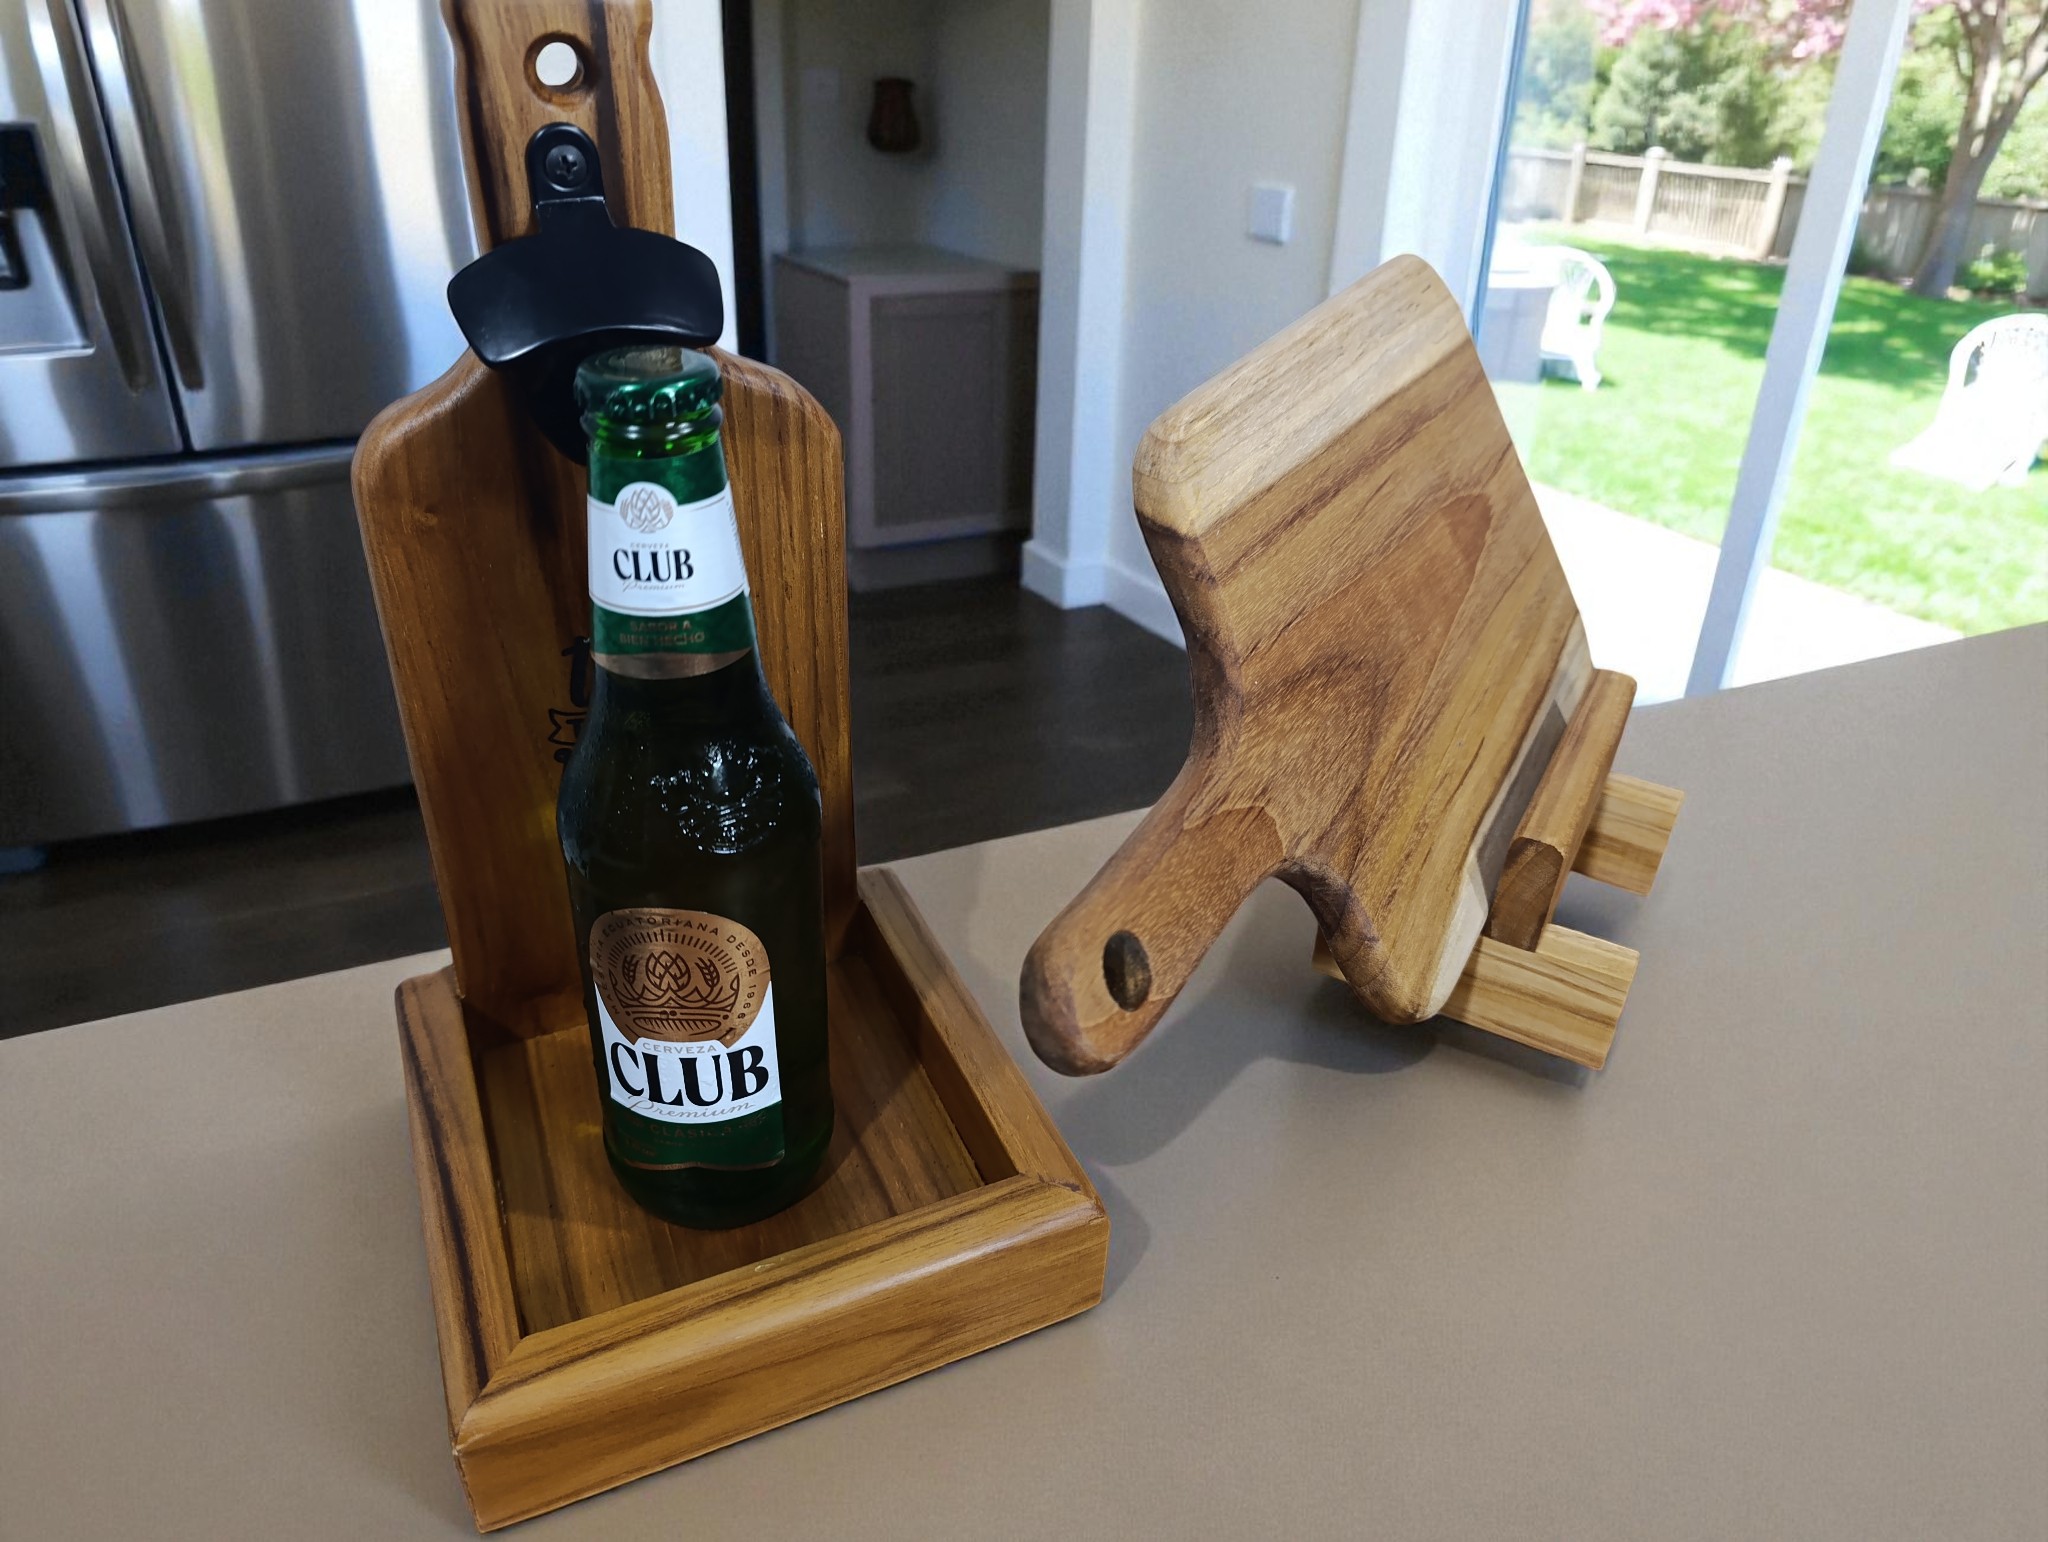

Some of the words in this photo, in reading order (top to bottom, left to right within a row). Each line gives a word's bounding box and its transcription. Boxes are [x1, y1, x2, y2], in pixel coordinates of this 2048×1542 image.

[613, 548, 694, 582] CLUB
[622, 580, 686, 592] Premium
[602, 917, 720, 937] ECUATORIANA
[726, 934, 757, 977] DESDE
[737, 984, 756, 1020] 1966
[643, 1042, 717, 1054] CERVEZA
[610, 1041, 770, 1107] CLUB
[627, 1096, 755, 1118] Premium
